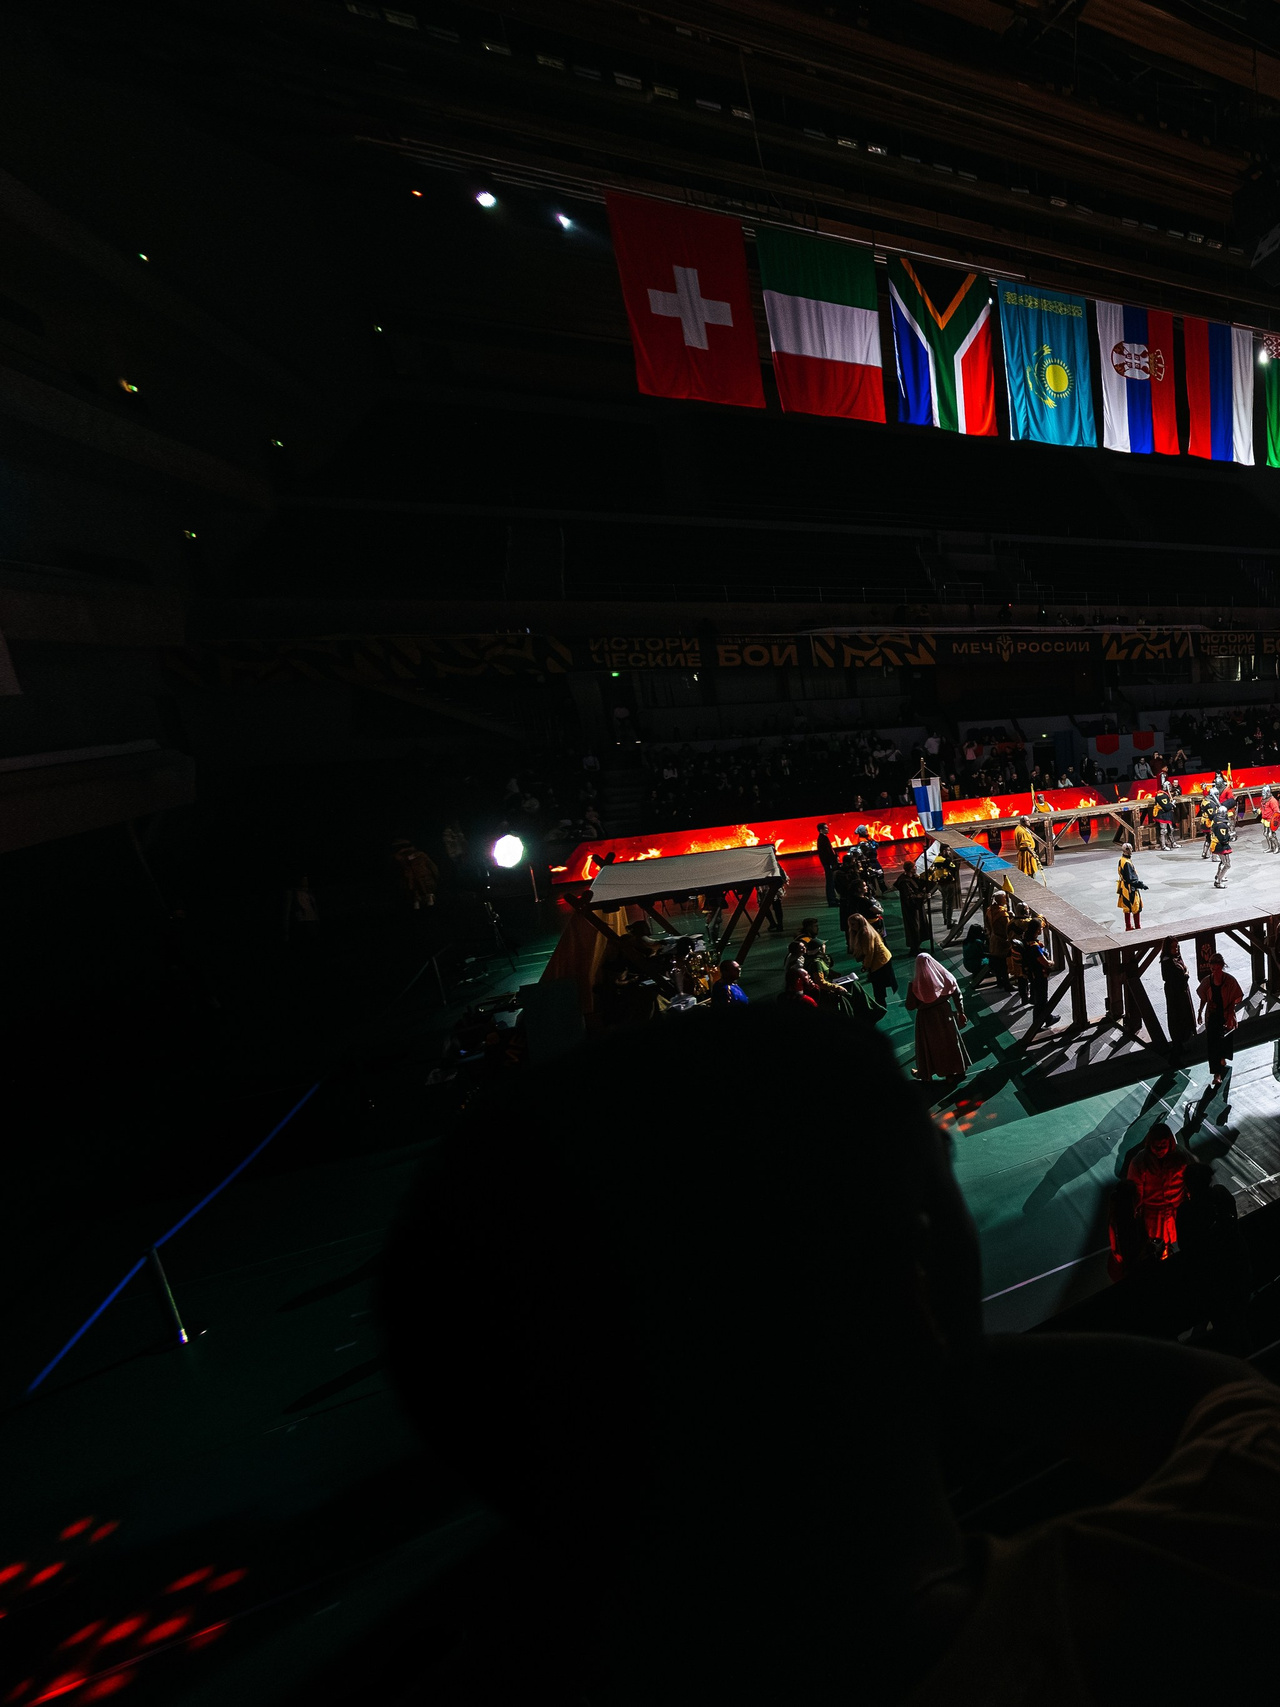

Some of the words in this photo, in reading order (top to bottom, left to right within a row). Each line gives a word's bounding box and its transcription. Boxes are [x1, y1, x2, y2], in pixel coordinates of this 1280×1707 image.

[589, 637, 700, 652] ИСТОРИ
[1199, 633, 1256, 645] ИСТОРИ
[951, 641, 993, 655] МЕЧ
[1016, 640, 1091, 653] РОССИИ
[1201, 645, 1256, 656] ЧЕСКИЕ
[592, 653, 703, 669] ЧЕСКИЕ
[717, 644, 799, 667] БОИ
